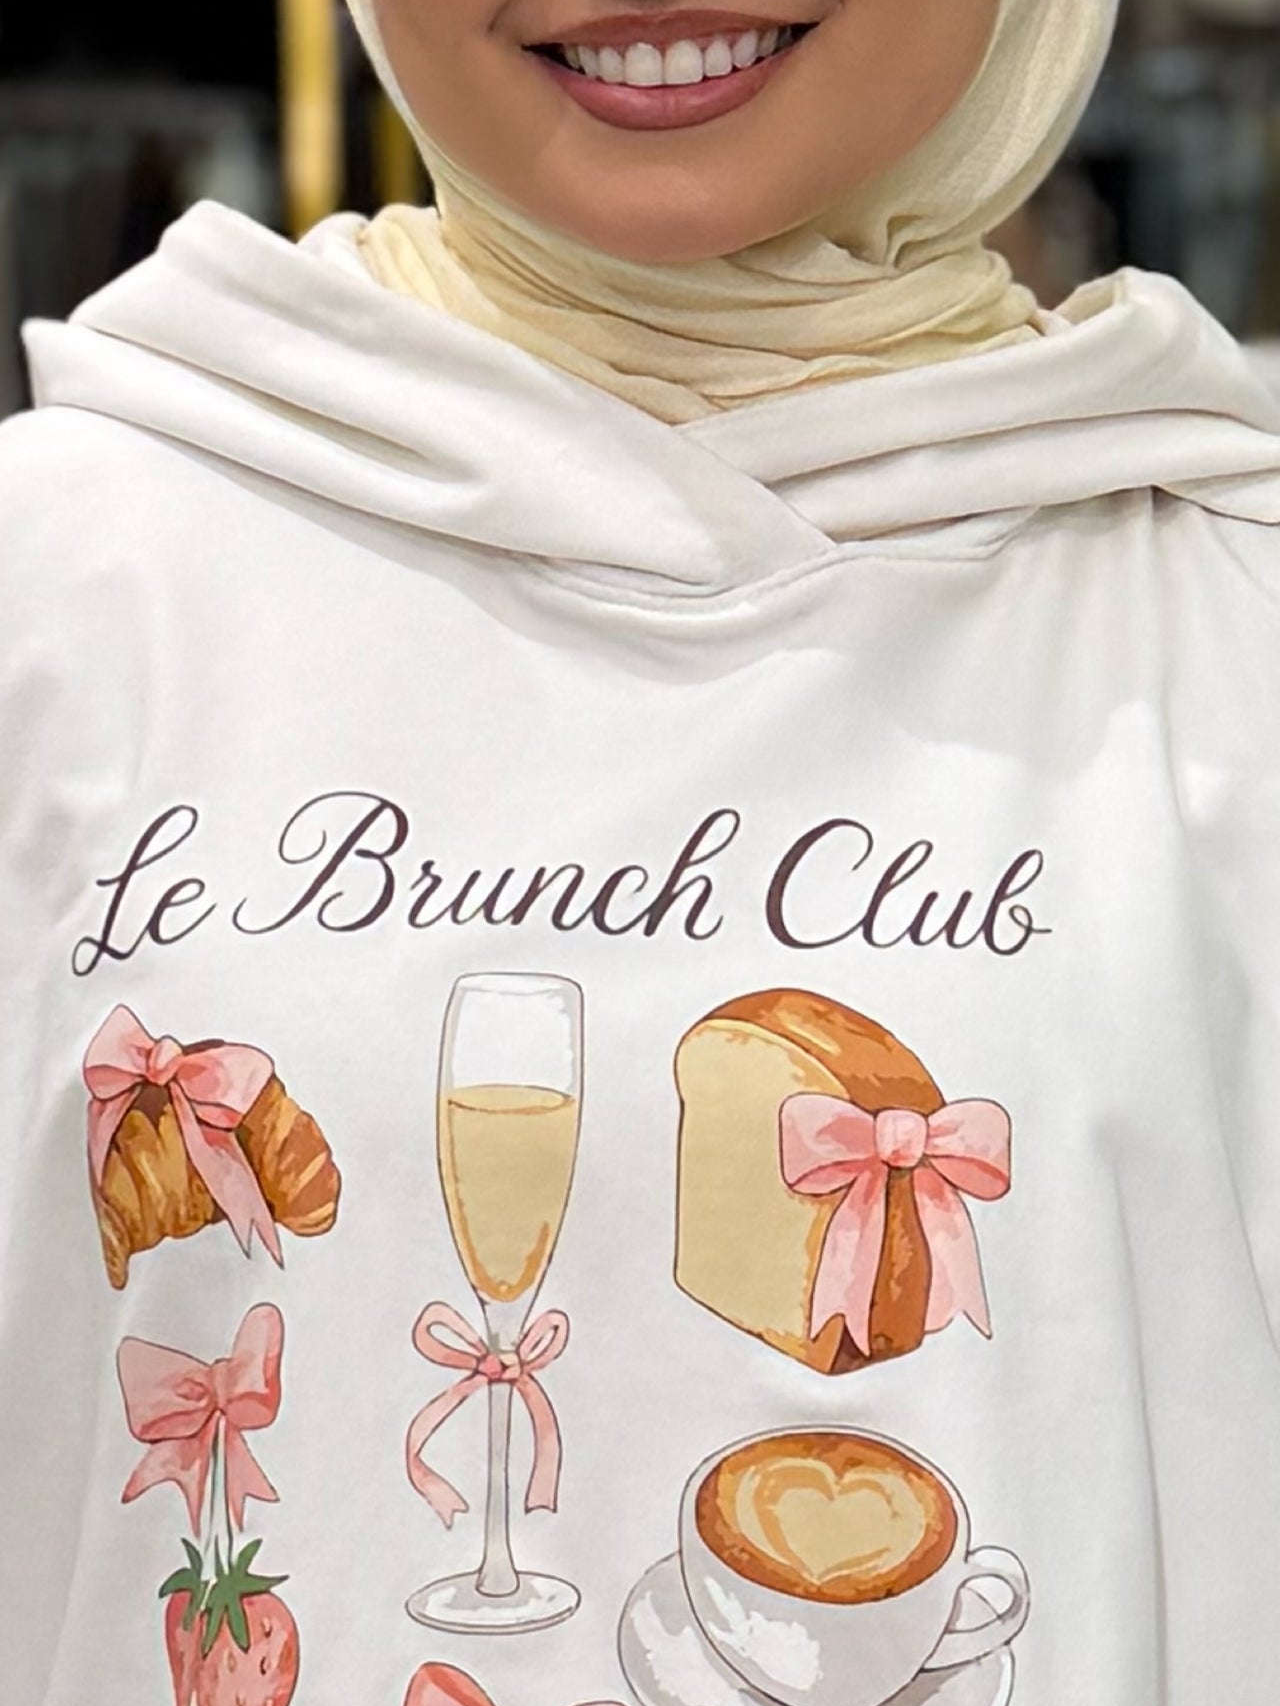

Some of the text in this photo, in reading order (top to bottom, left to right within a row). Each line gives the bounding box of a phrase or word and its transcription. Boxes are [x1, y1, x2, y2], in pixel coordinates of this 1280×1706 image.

[70, 790, 1053, 978] Le Brunch Club
